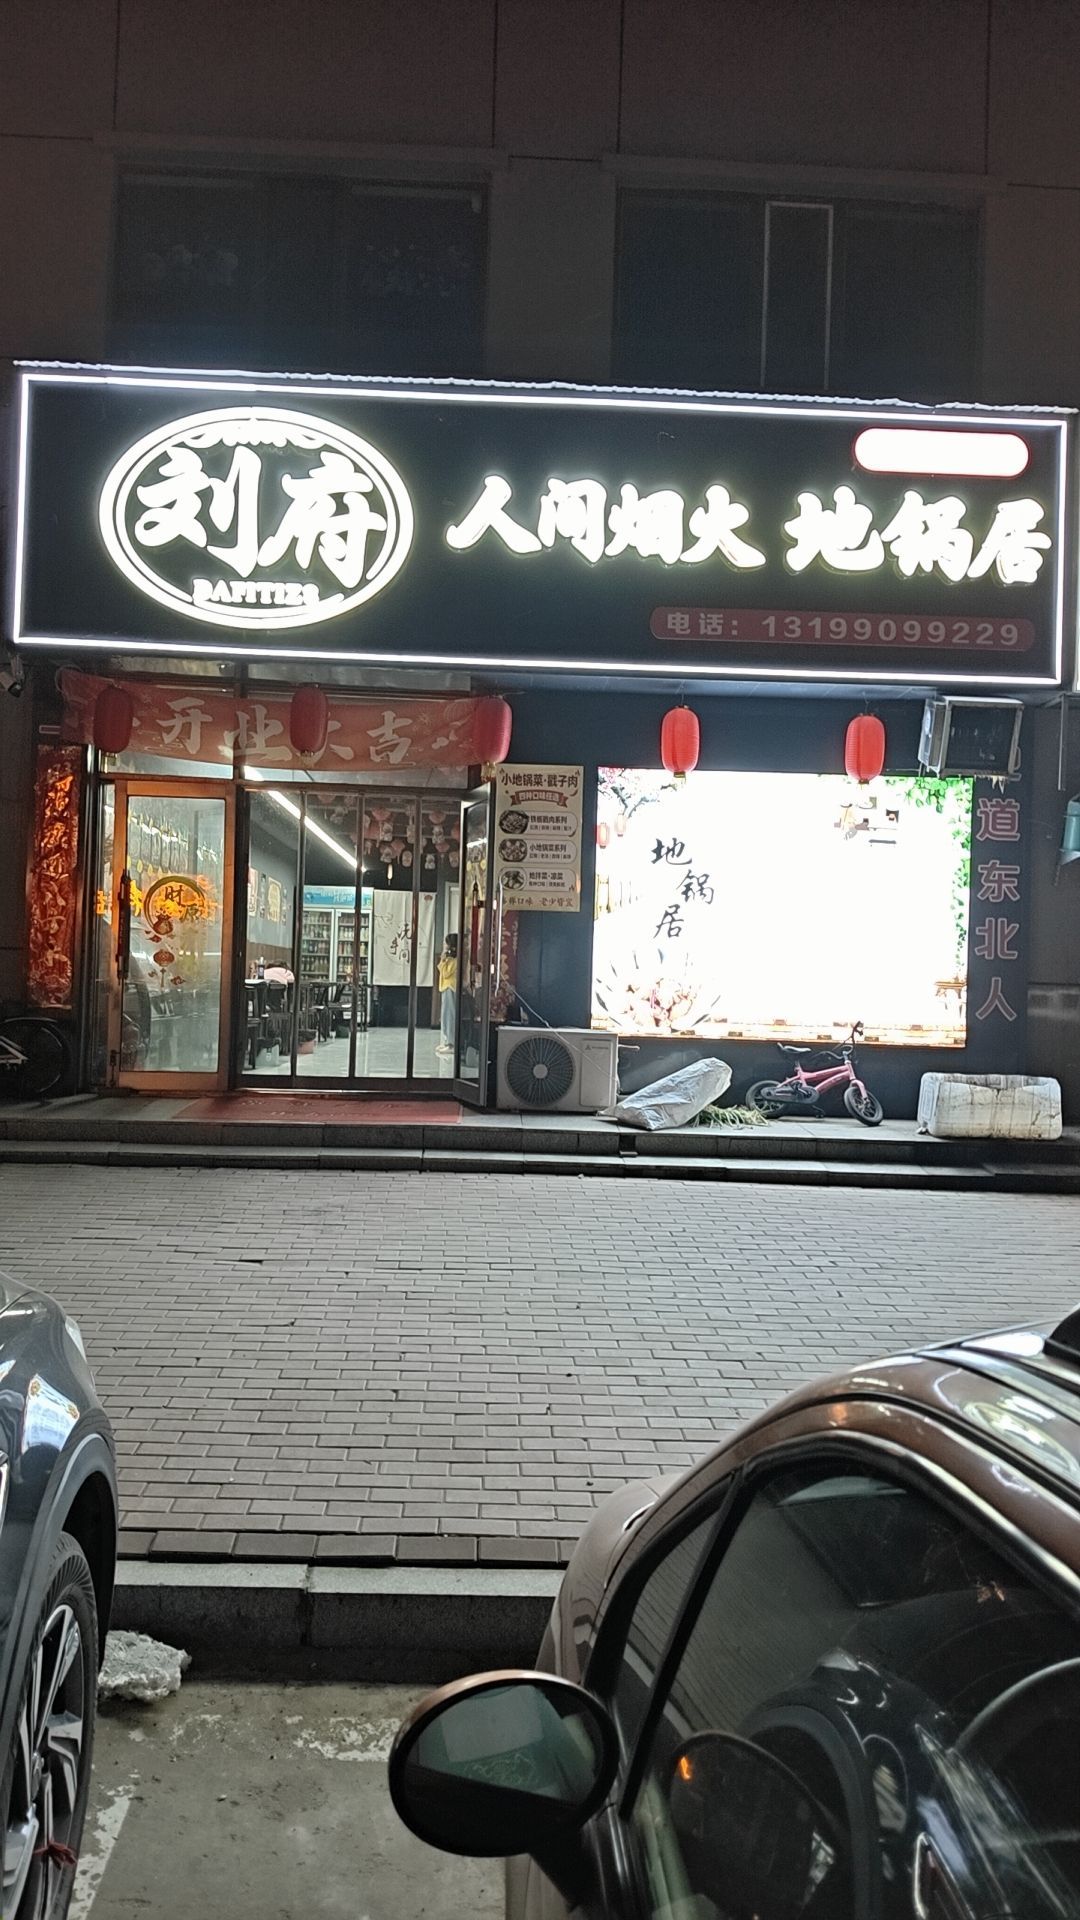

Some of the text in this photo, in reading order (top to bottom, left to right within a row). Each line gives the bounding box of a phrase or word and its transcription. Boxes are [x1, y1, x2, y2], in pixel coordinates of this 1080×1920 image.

[135, 445, 388, 588] 刘府
[446, 474, 1053, 586] 人间烟火 地锅居
[651, 837, 714, 939] 地锅居
[975, 746, 1021, 1022] 道东北人
